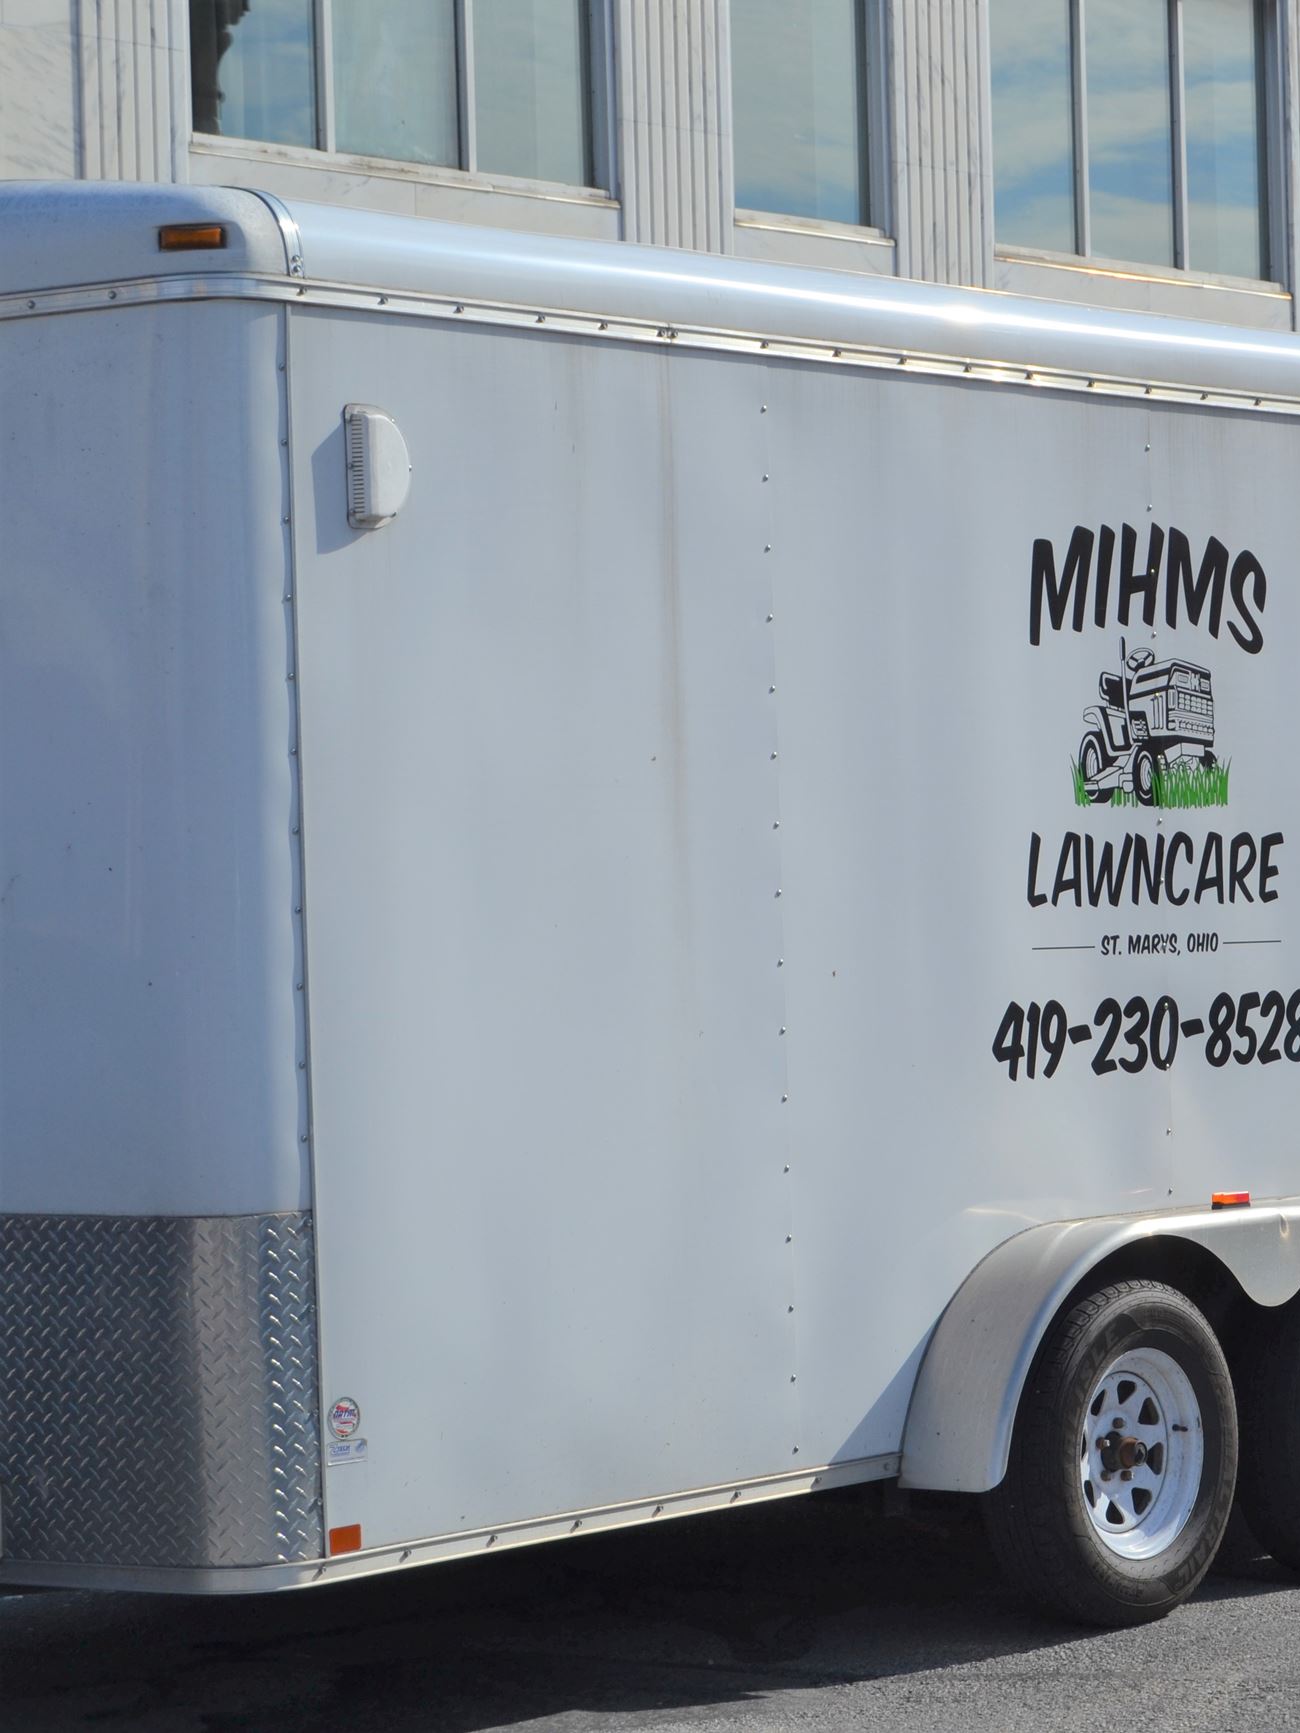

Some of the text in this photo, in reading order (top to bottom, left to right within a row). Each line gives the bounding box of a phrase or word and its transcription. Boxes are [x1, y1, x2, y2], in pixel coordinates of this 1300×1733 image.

[1029, 522, 1267, 655] MIHMS
[1026, 831, 1284, 907] LAWNCARE
[1100, 932, 1219, 956] ST. MARYS, OHIO
